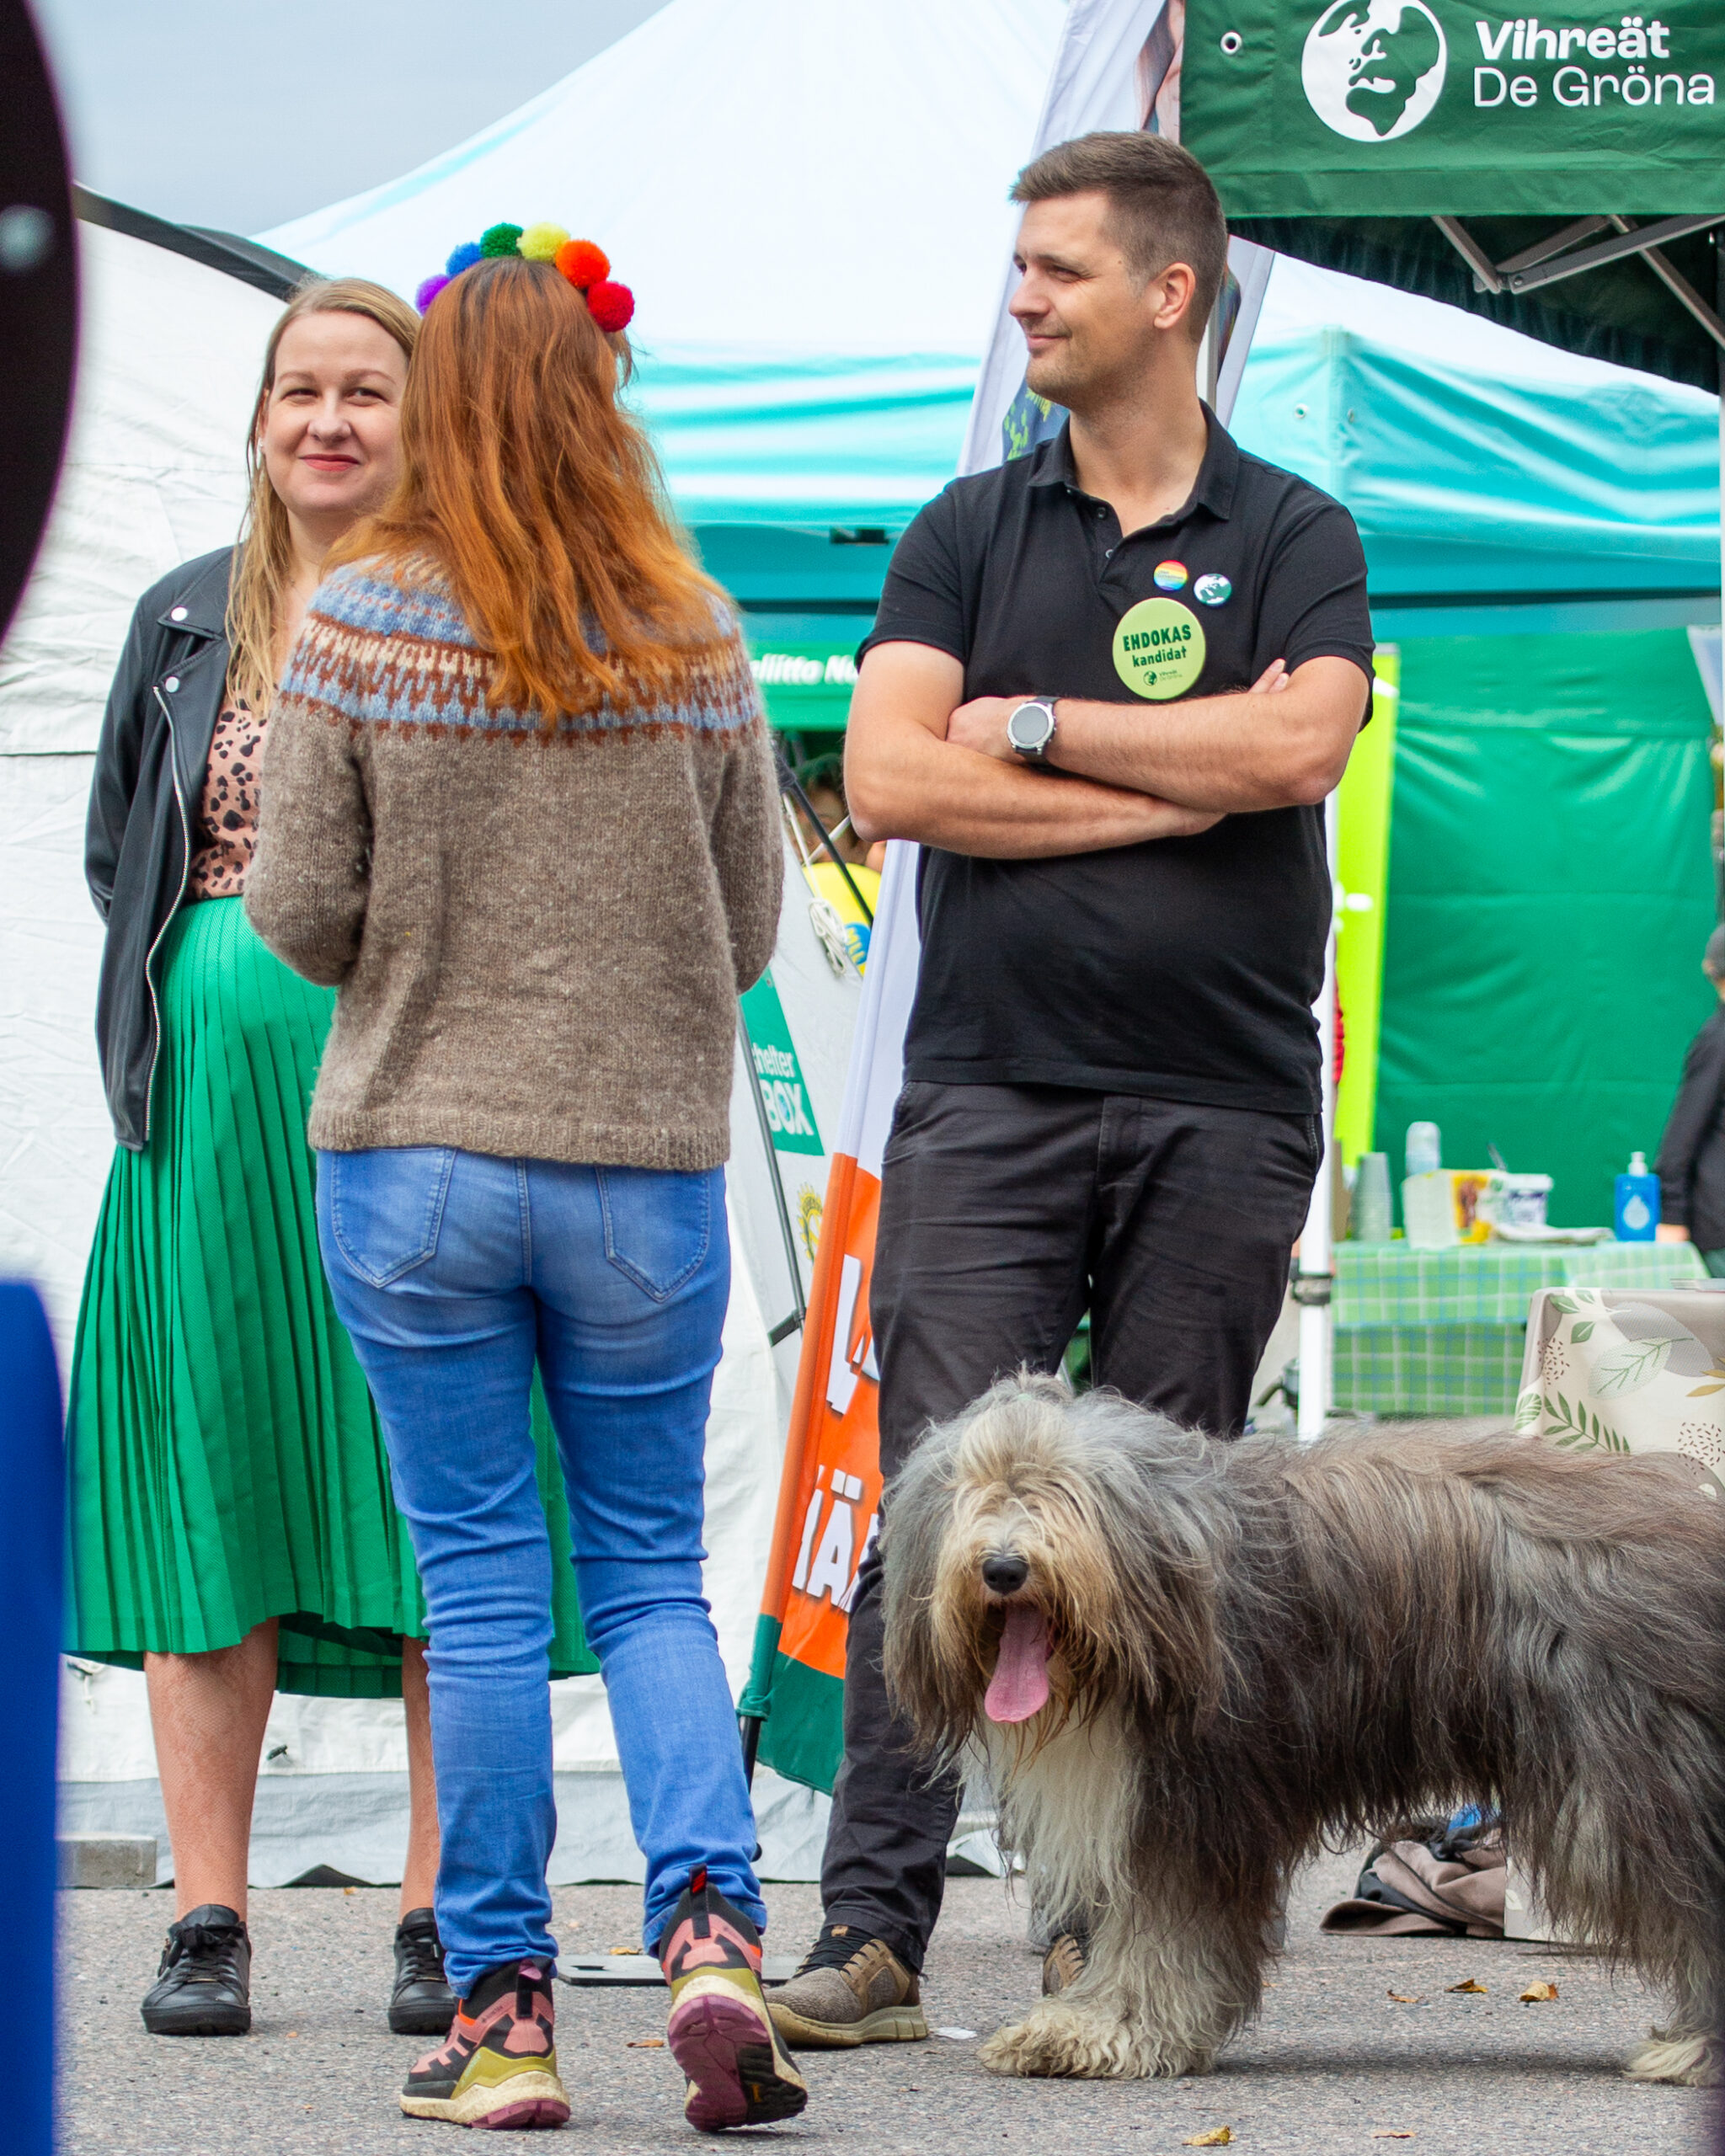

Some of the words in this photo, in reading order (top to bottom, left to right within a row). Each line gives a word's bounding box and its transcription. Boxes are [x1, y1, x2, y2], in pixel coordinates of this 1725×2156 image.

[1475, 16, 1669, 60] Vihreät
[1474, 67, 1537, 107] De
[1552, 65, 1715, 107] Gröna
[1123, 624, 1191, 652] EHDOKAS
[1132, 646, 1187, 667] kandidat
[752, 1043, 795, 1078] helter
[760, 1079, 814, 1135] BOX
